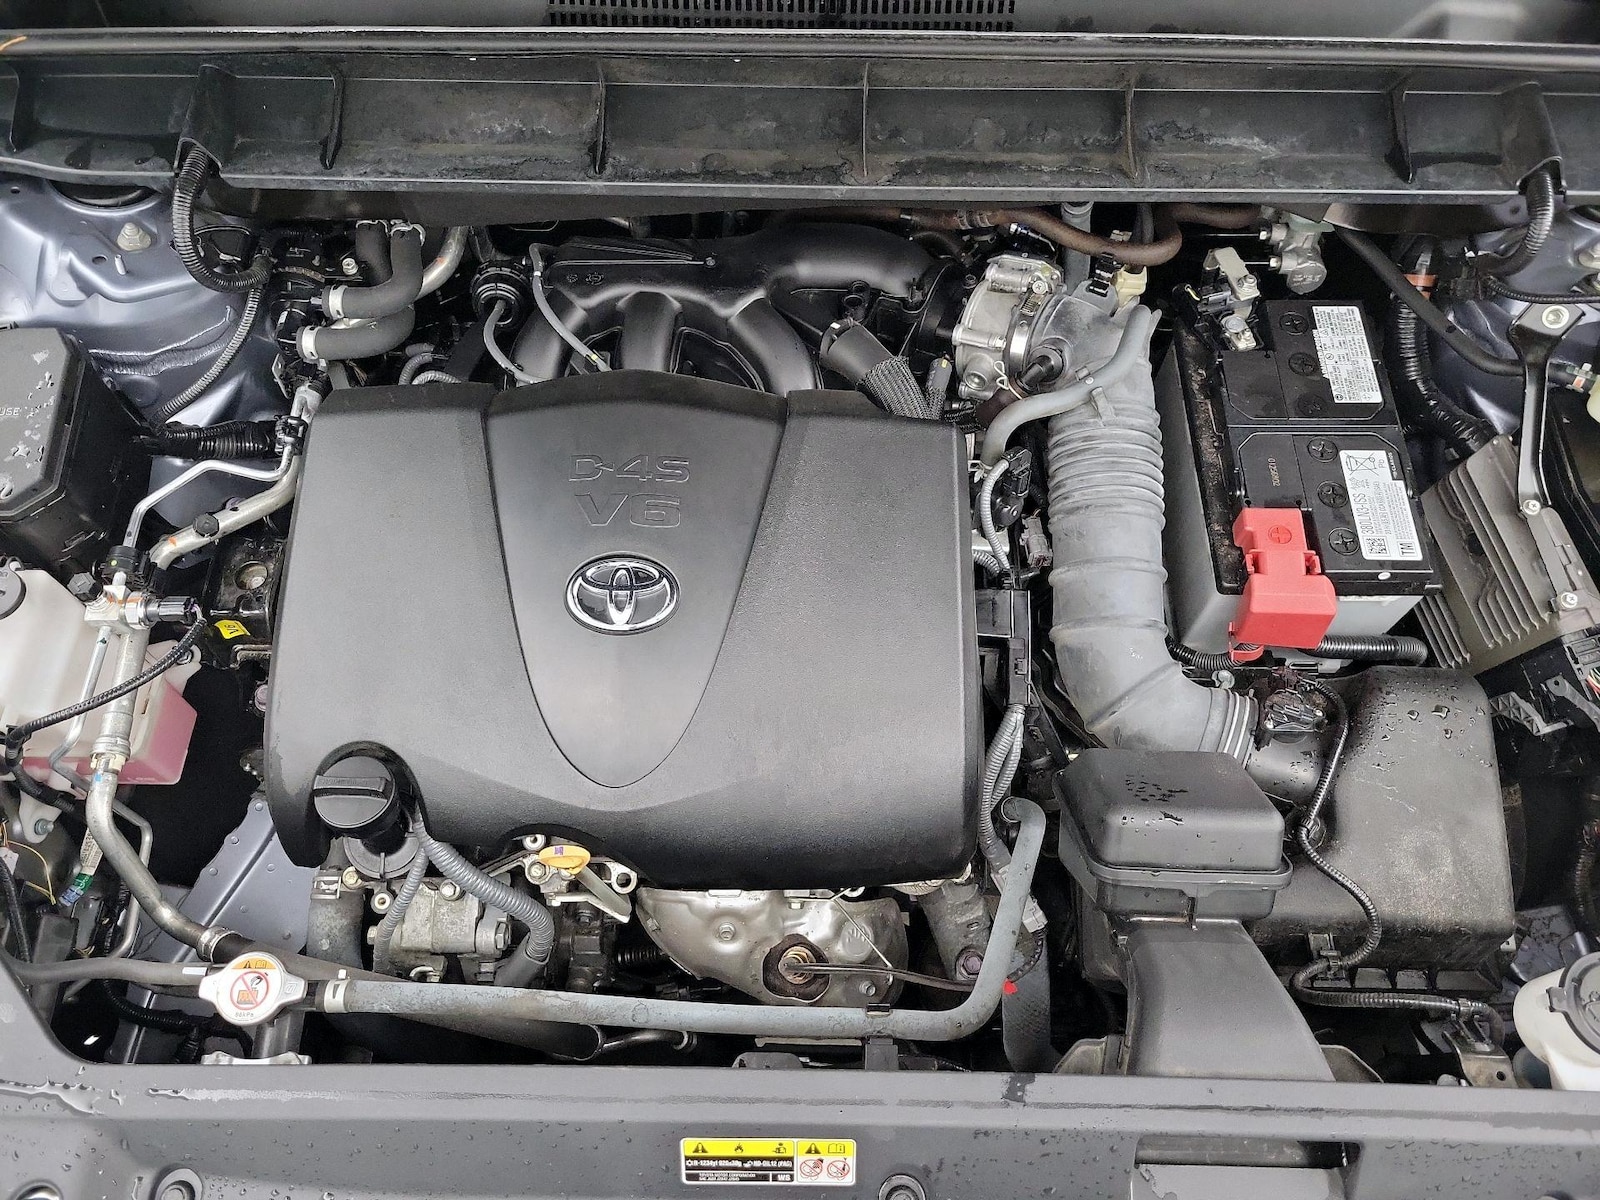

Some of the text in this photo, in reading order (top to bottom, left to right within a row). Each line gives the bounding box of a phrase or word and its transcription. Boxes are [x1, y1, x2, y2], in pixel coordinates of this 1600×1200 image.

[569, 454, 690, 483] D-4S
[1378, 459, 1387, 469] Pb
[574, 492, 682, 528] V6
[1399, 542, 1416, 556] TM
[778, 1174, 791, 1182] WS
